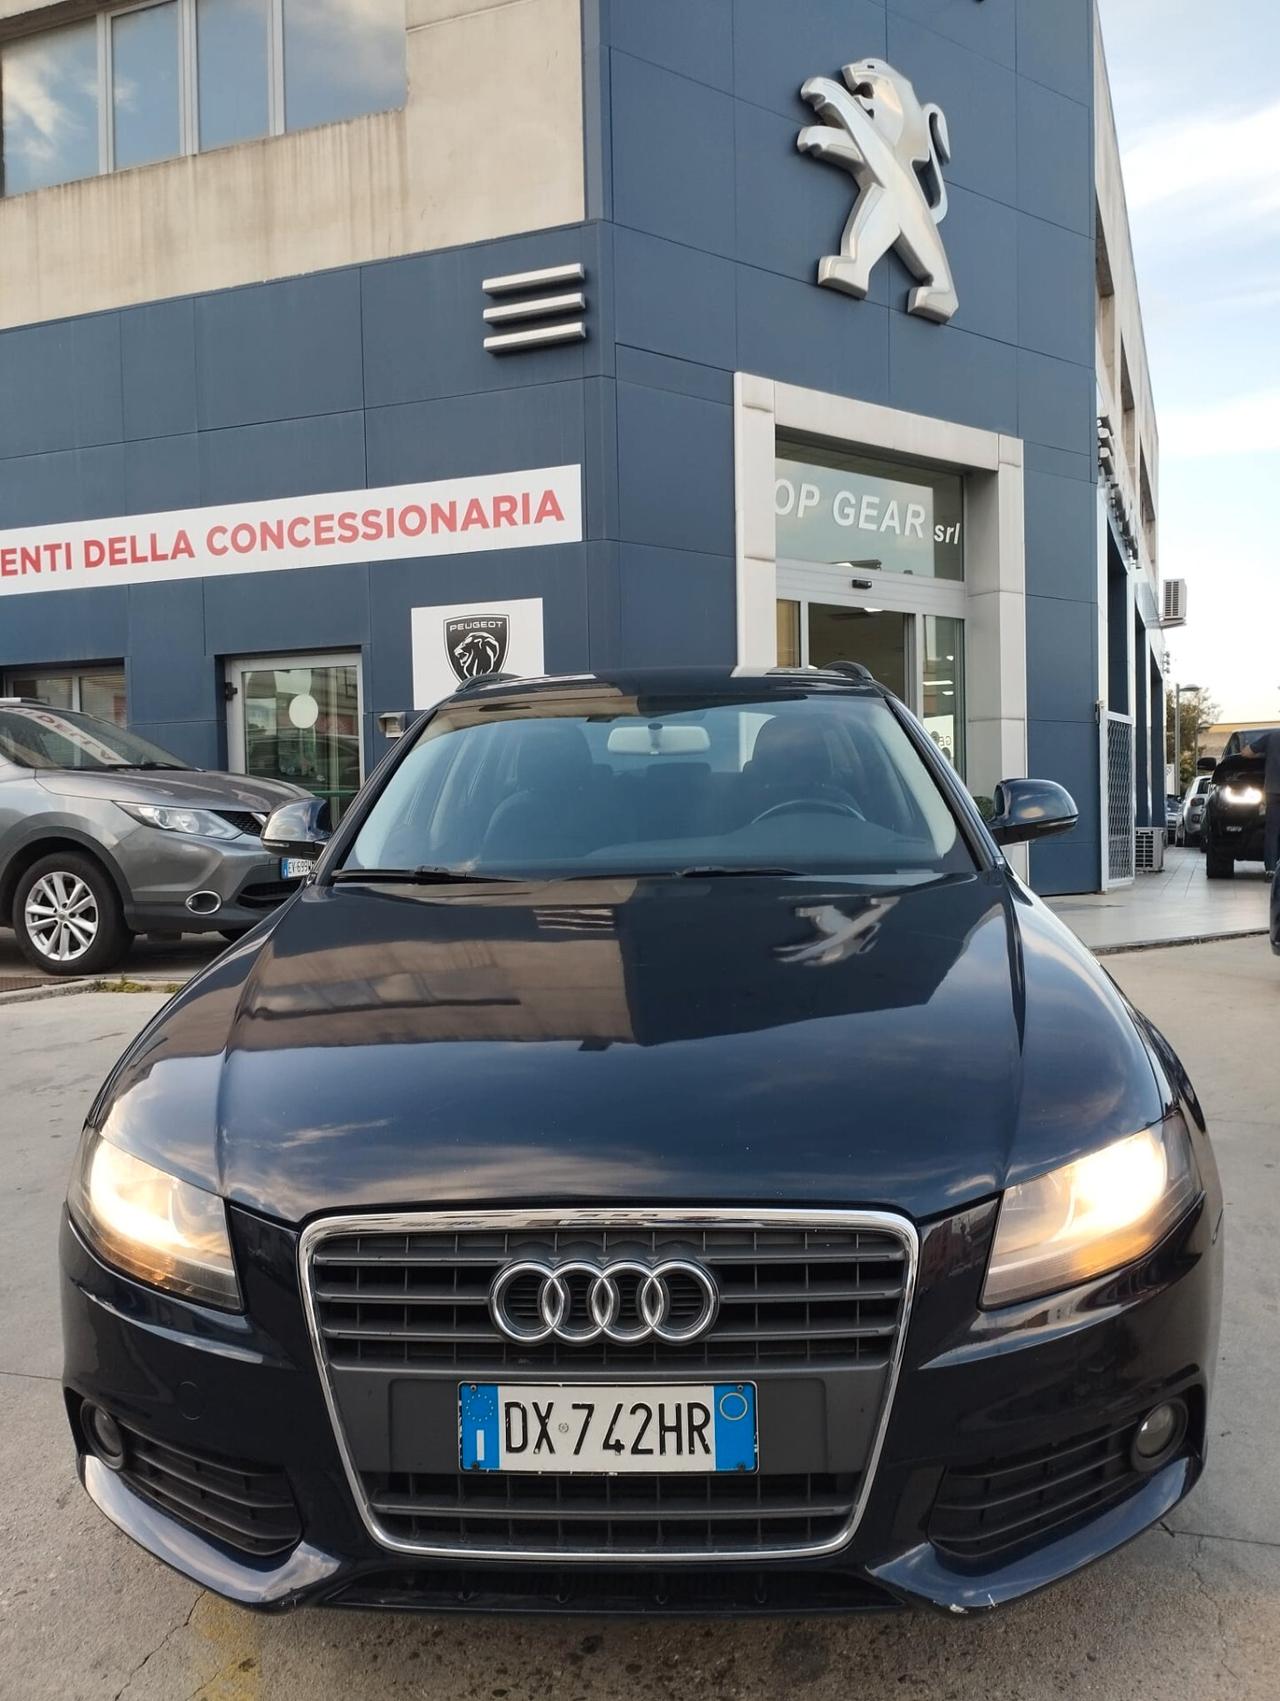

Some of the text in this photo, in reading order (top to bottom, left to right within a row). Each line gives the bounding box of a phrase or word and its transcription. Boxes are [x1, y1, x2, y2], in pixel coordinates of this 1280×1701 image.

[0, 489, 565, 577] ENTI DELLA CONCESSIONARIA
[833, 490, 926, 538] GEAR
[934, 523, 960, 545] srl
[449, 621, 503, 632] PEUGEOT
